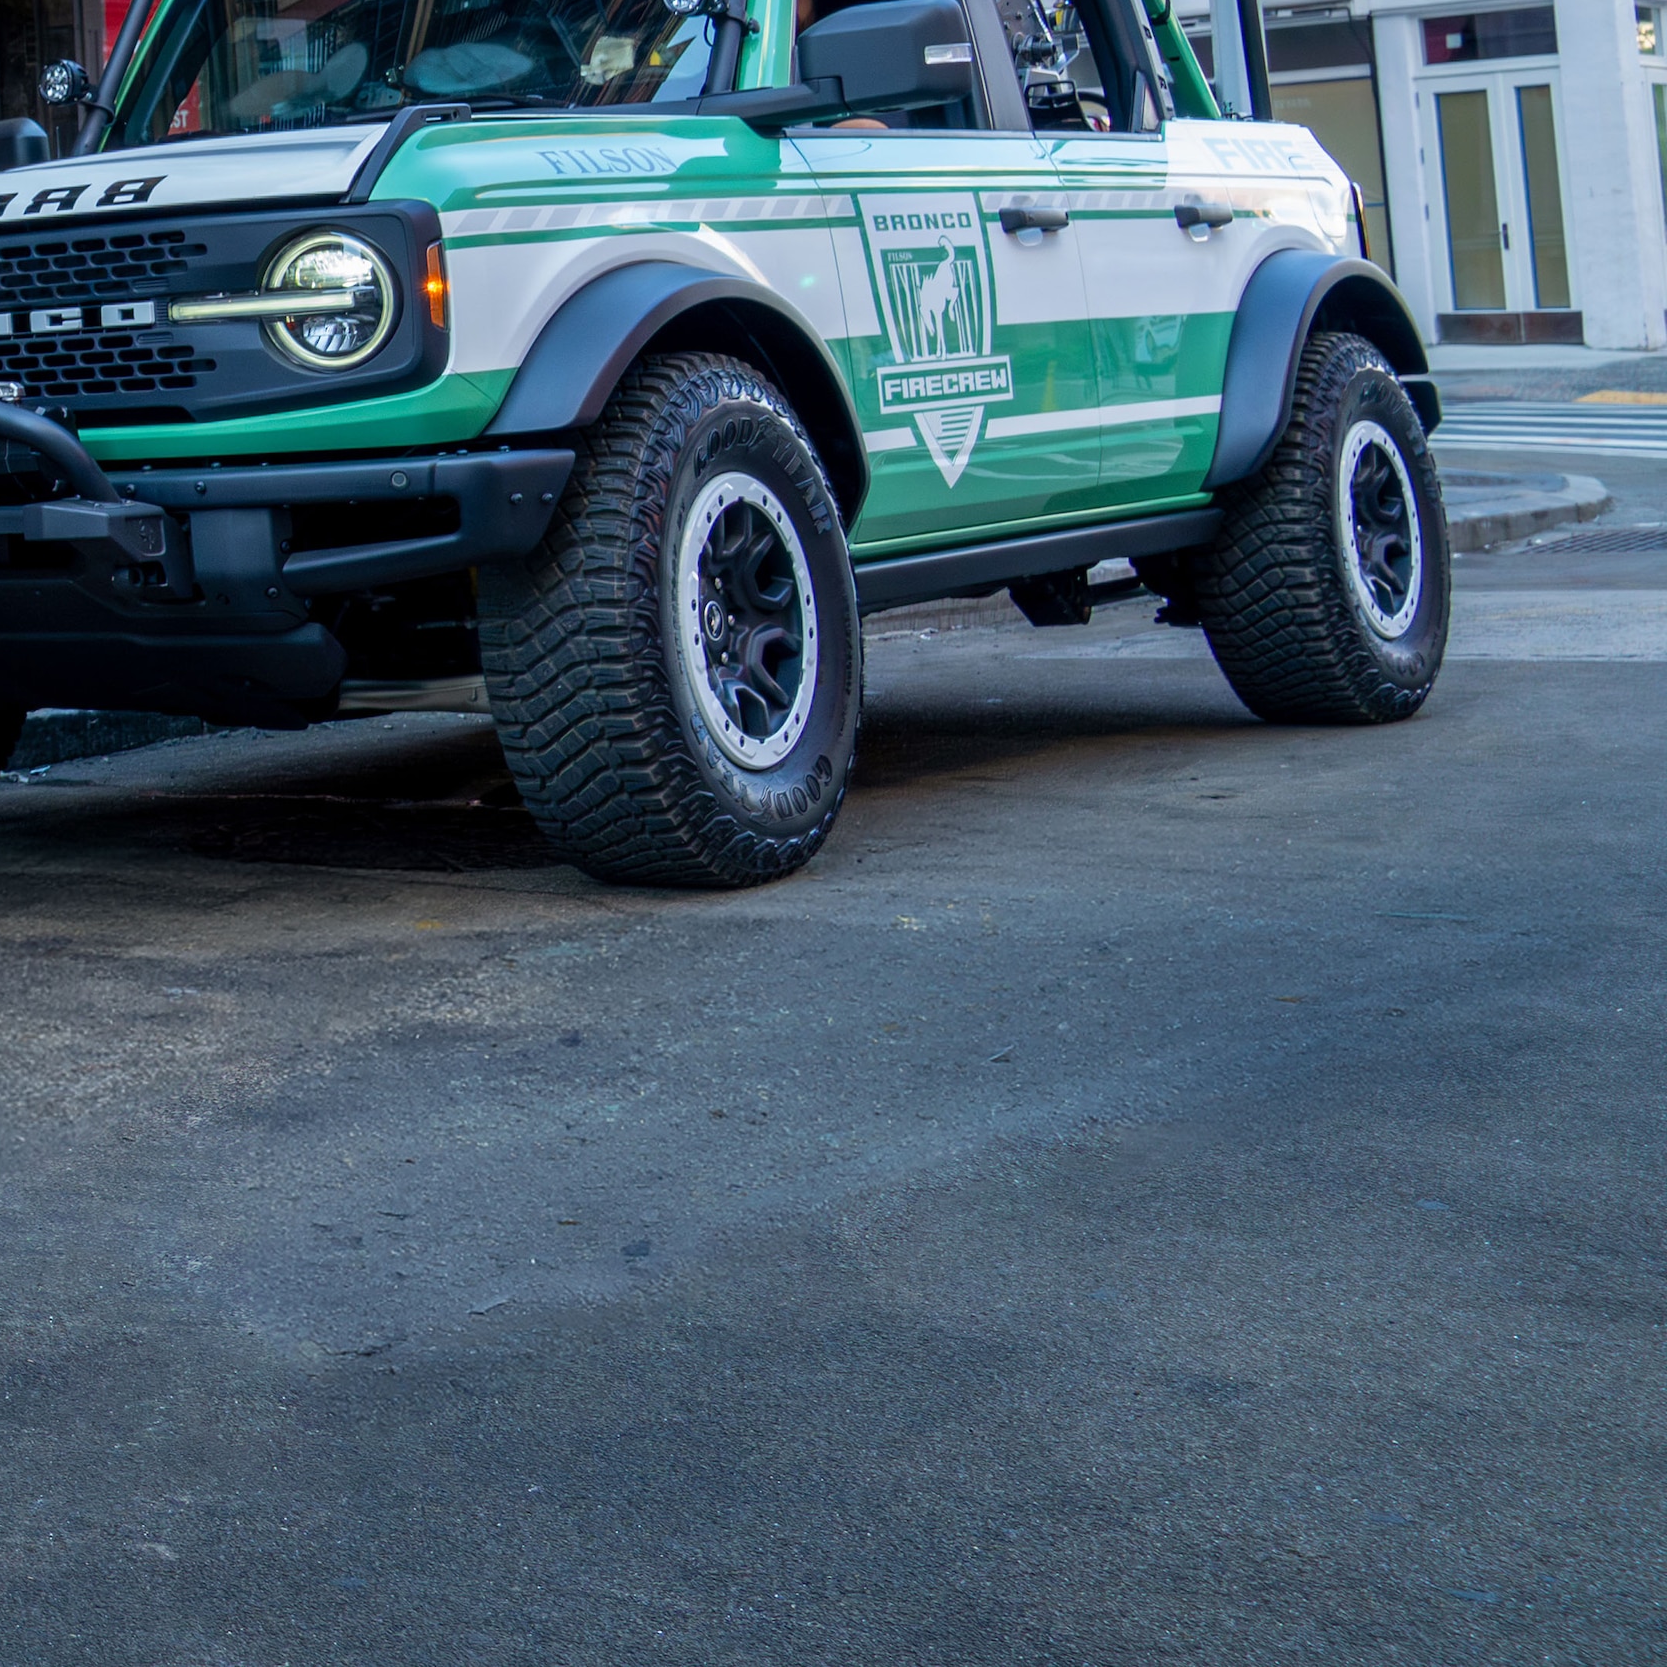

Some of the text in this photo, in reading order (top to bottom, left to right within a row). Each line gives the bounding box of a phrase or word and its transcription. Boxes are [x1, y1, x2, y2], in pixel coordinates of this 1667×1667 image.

[535, 147, 678, 175] FILSON
[1202, 137, 1315, 171] FIRE
[873, 212, 972, 232] BRONCO
[887, 251, 914, 262] FILSON
[884, 368, 1008, 401] FIRECREW
